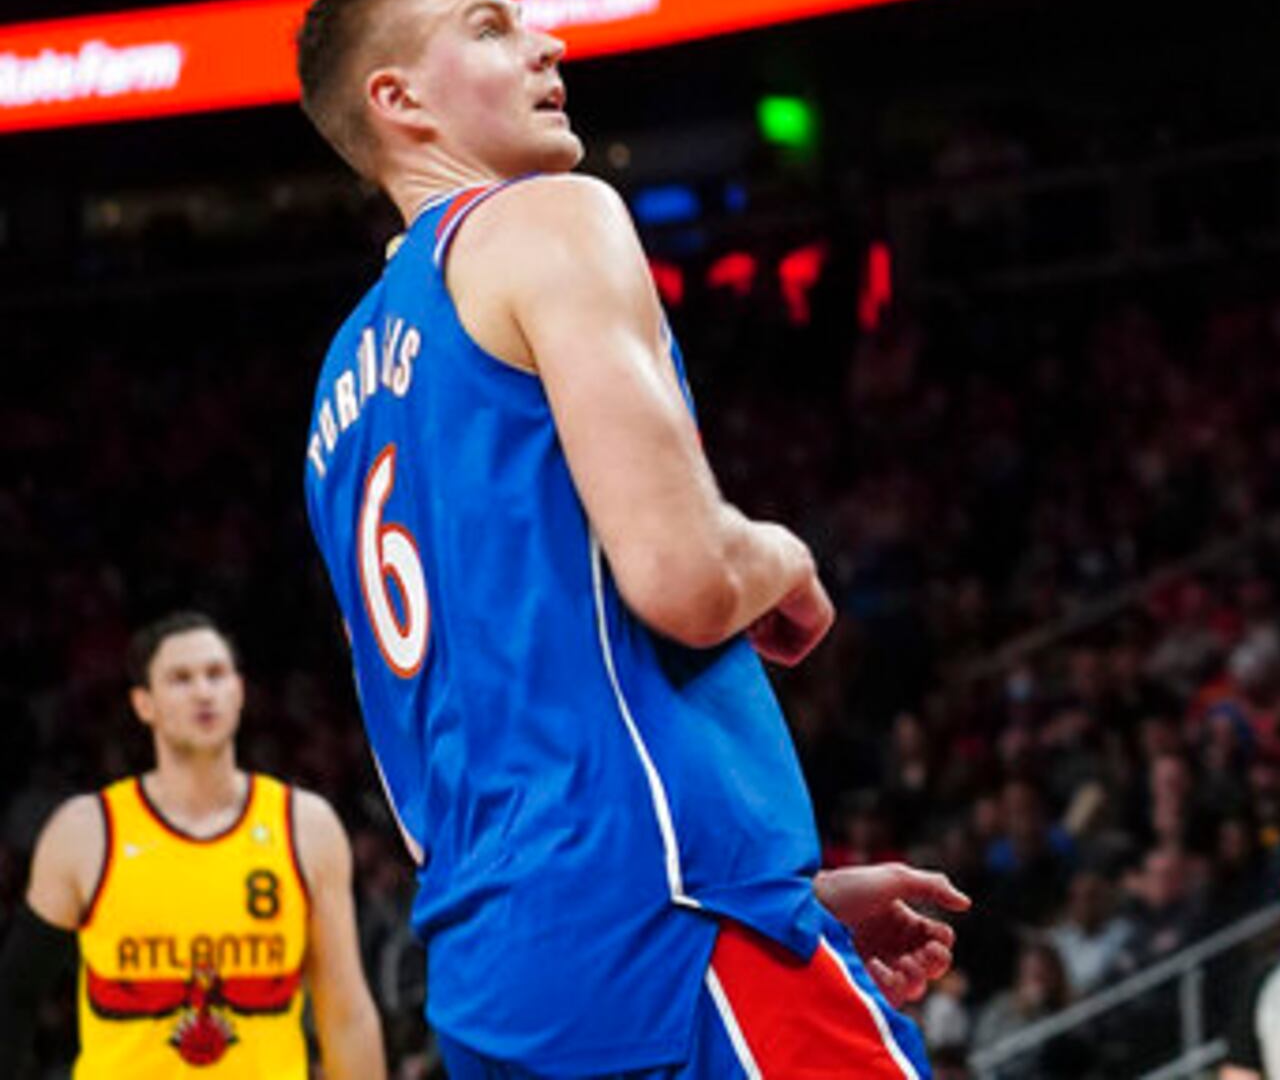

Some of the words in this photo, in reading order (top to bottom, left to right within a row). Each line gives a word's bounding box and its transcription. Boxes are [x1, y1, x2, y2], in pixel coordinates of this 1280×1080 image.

[0, 39, 183, 107] tateFarm
[356, 442, 432, 680] 6
[245, 869, 281, 921] 8
[117, 933, 286, 972] ATLANTA
